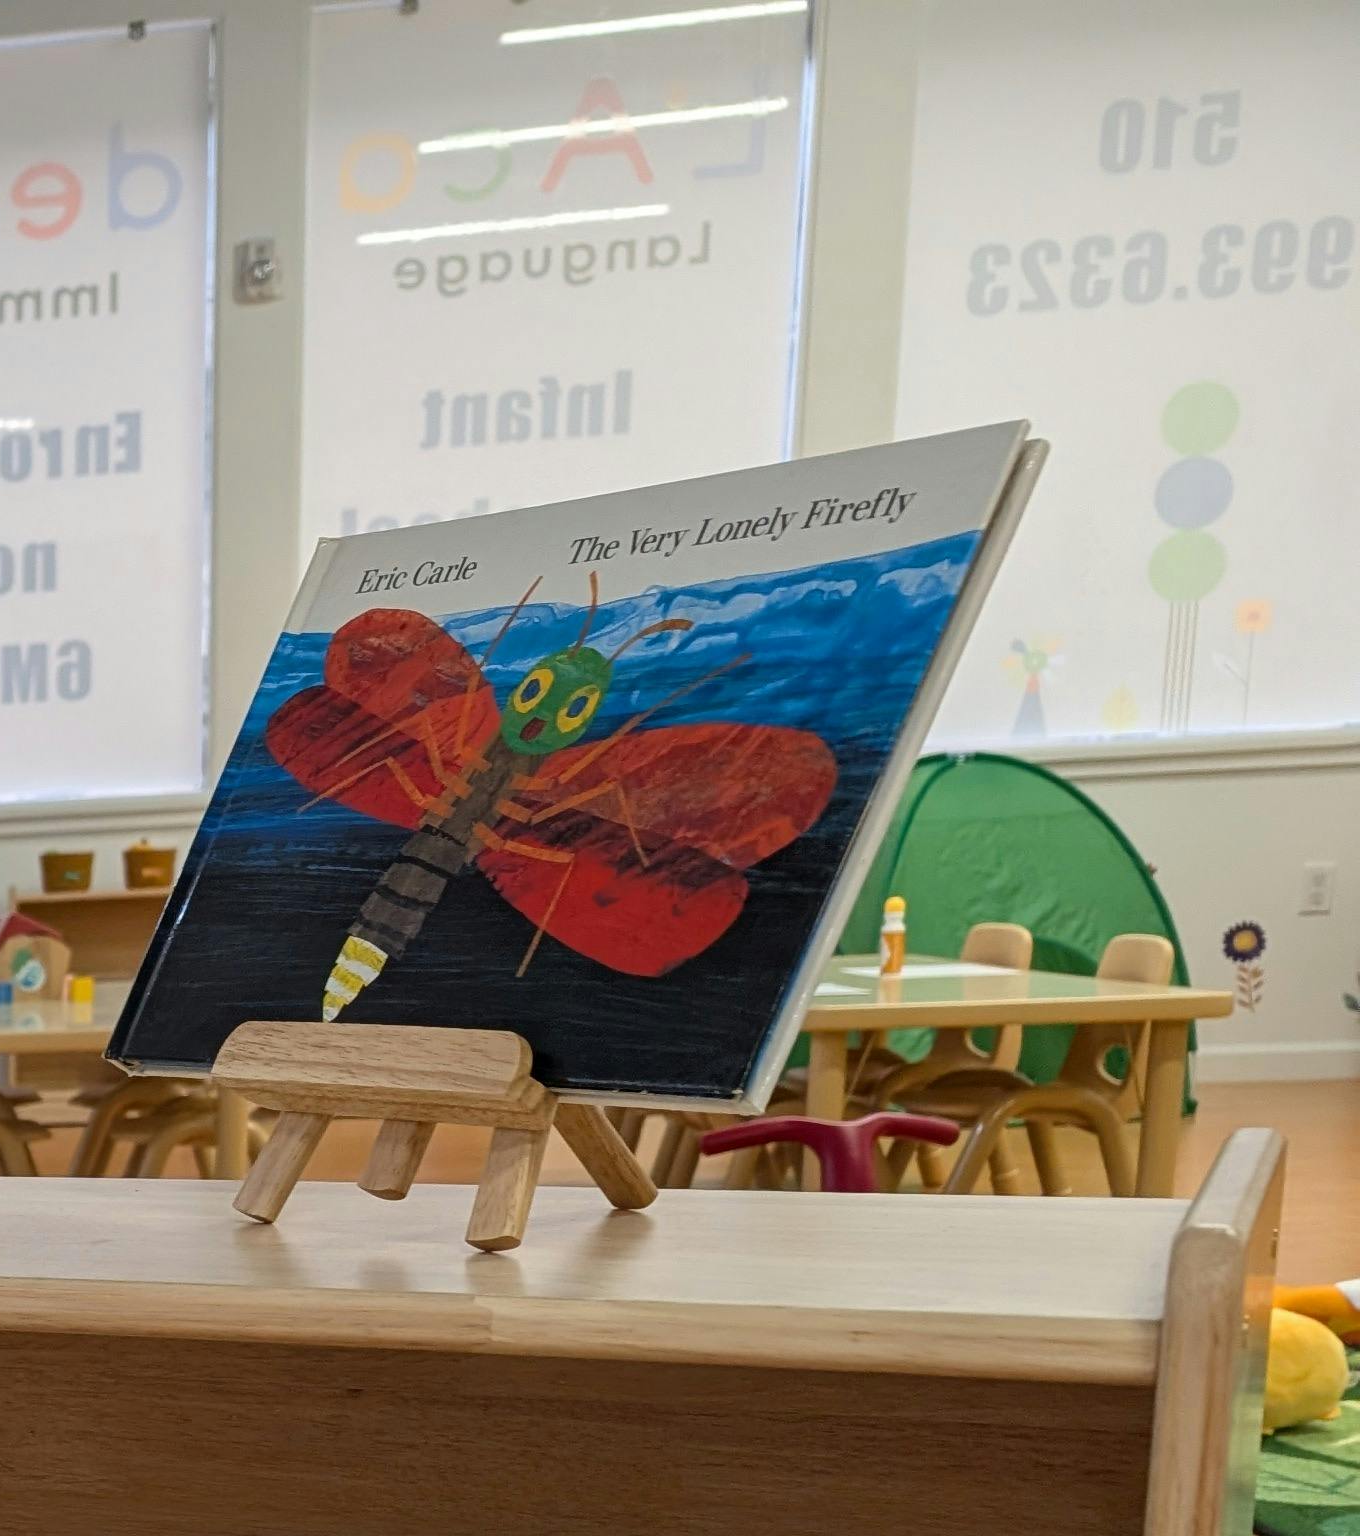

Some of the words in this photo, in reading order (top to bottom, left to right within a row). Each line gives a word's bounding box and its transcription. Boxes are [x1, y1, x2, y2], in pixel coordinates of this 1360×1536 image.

[568, 535, 620, 565] The
[628, 526, 691, 557] Very
[692, 504, 798, 547] Lonely
[800, 486, 918, 530] Firefly
[355, 566, 408, 595] Eric
[412, 556, 478, 588] Carle
